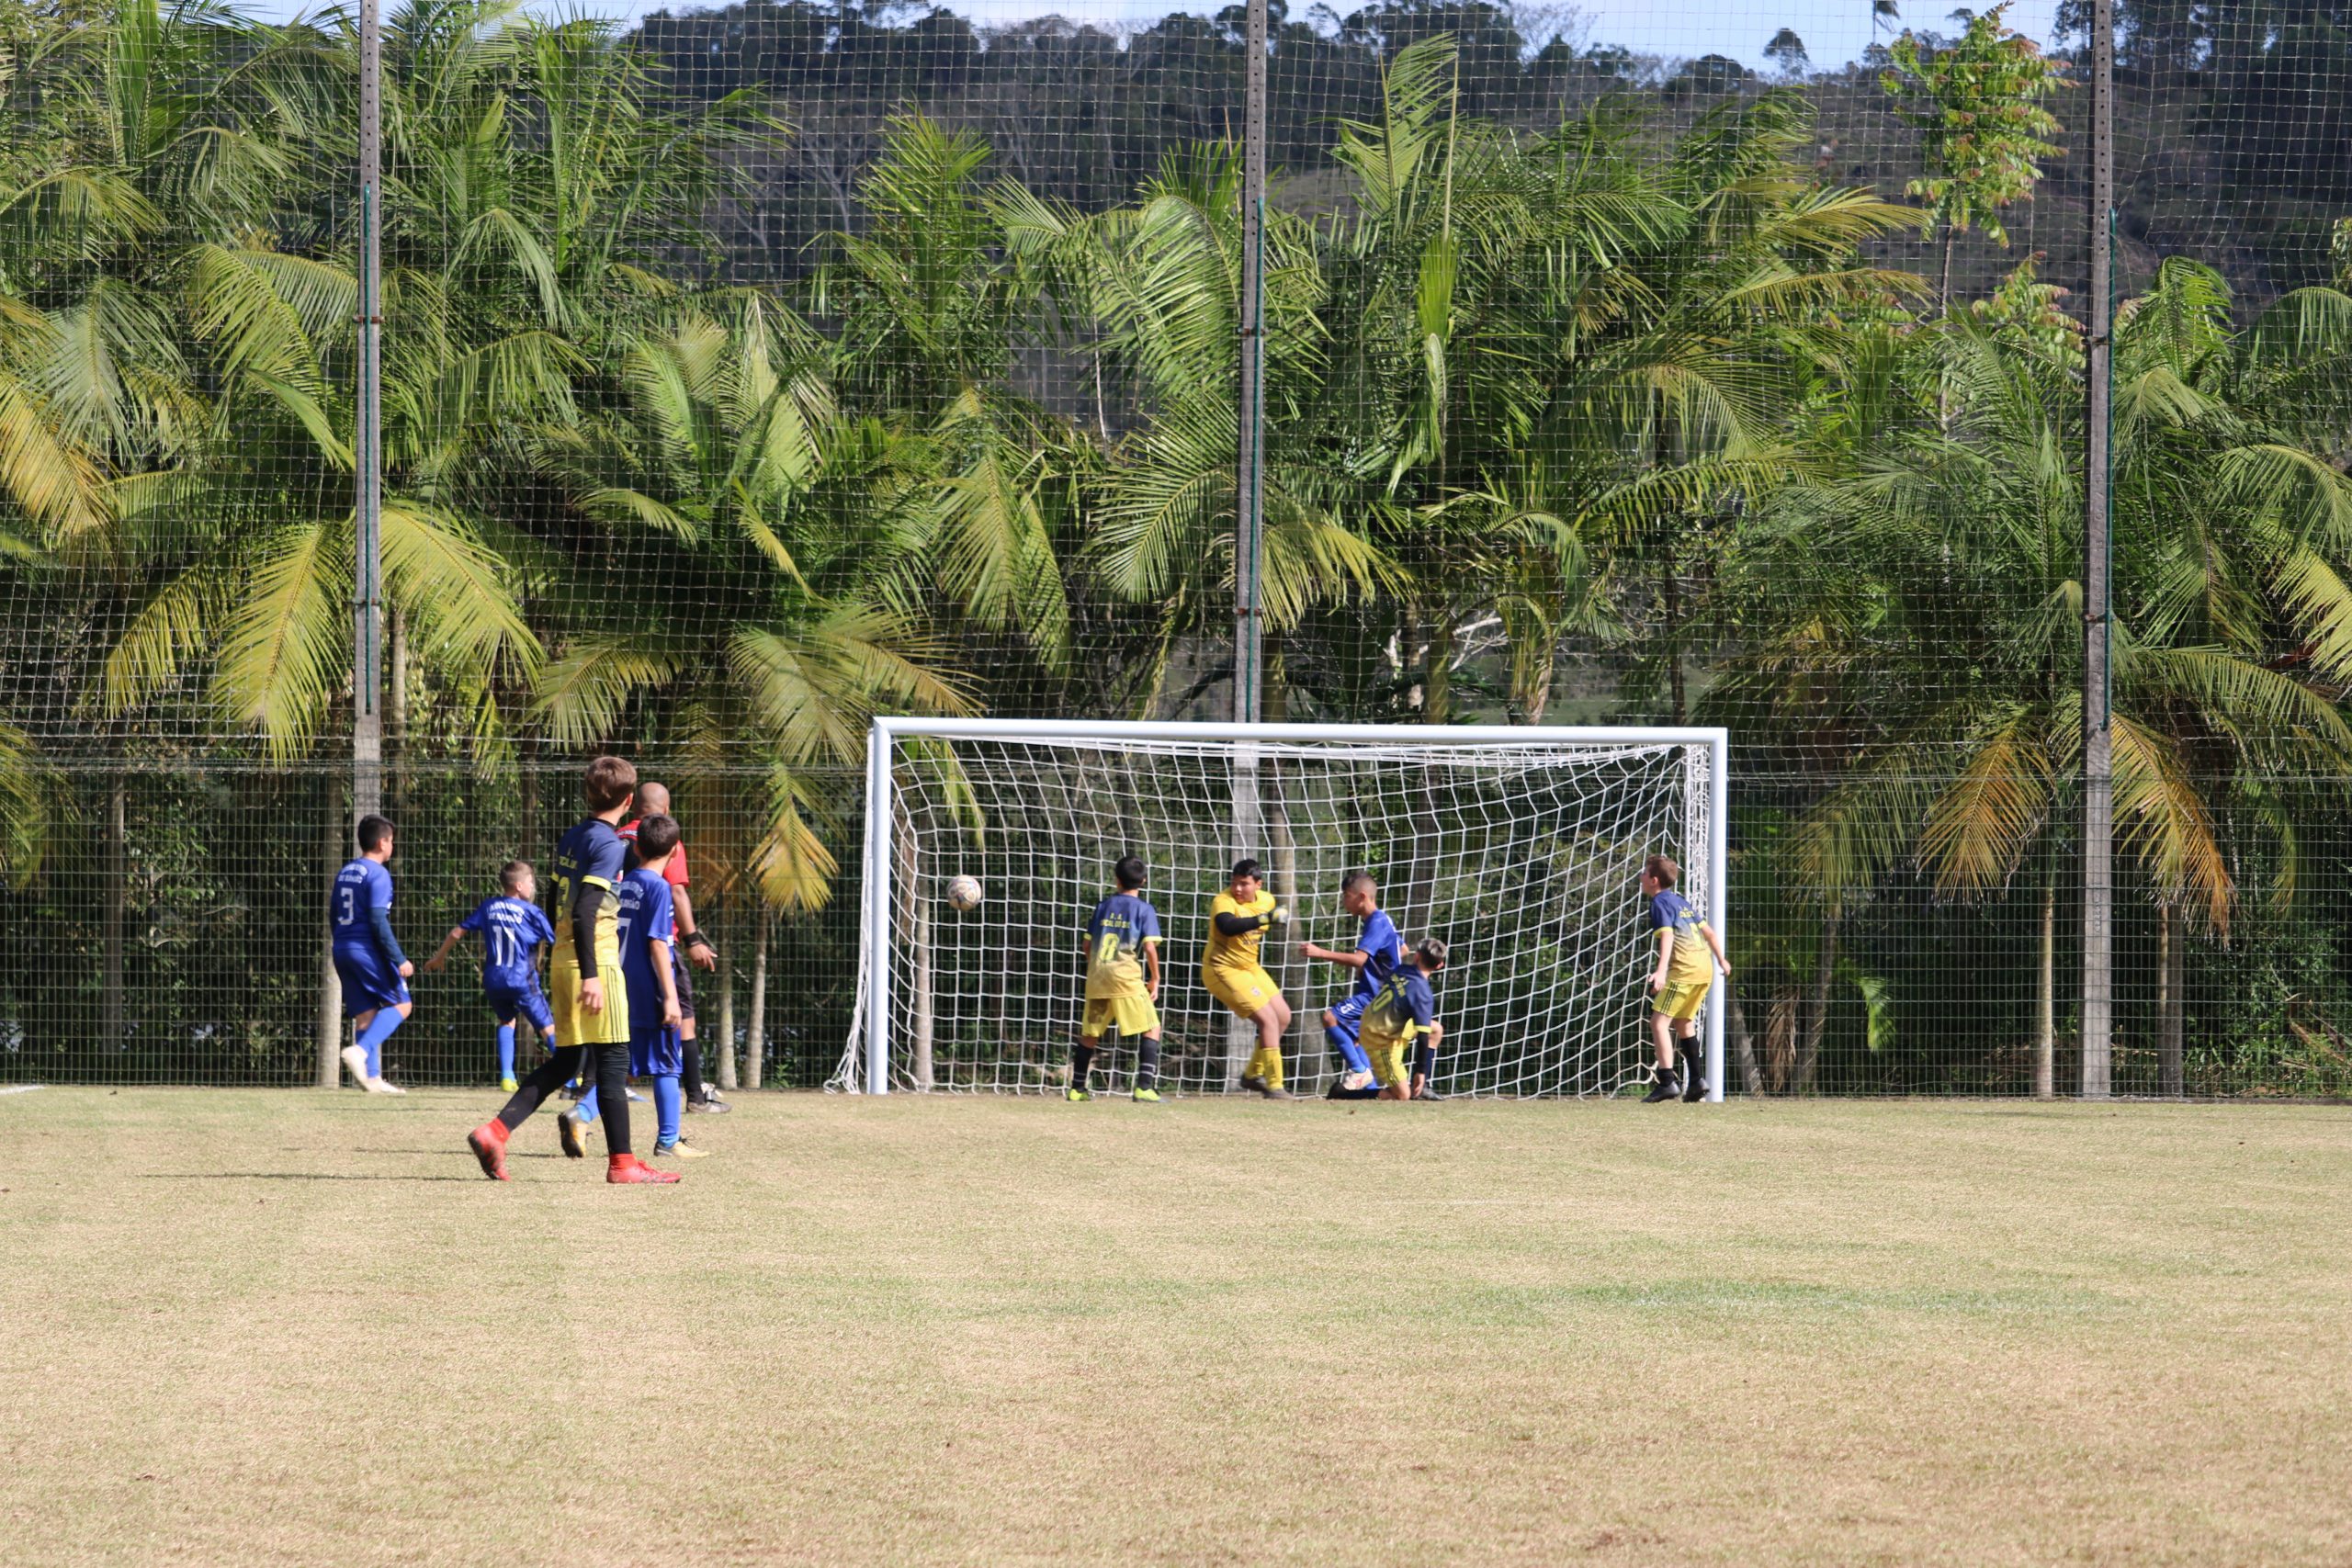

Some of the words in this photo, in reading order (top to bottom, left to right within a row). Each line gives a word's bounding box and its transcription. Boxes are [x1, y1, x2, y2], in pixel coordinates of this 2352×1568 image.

[338, 887, 354, 925] 3
[492, 925, 515, 968] 11
[616, 918, 633, 969] 7
[1100, 932, 1120, 962] 8
